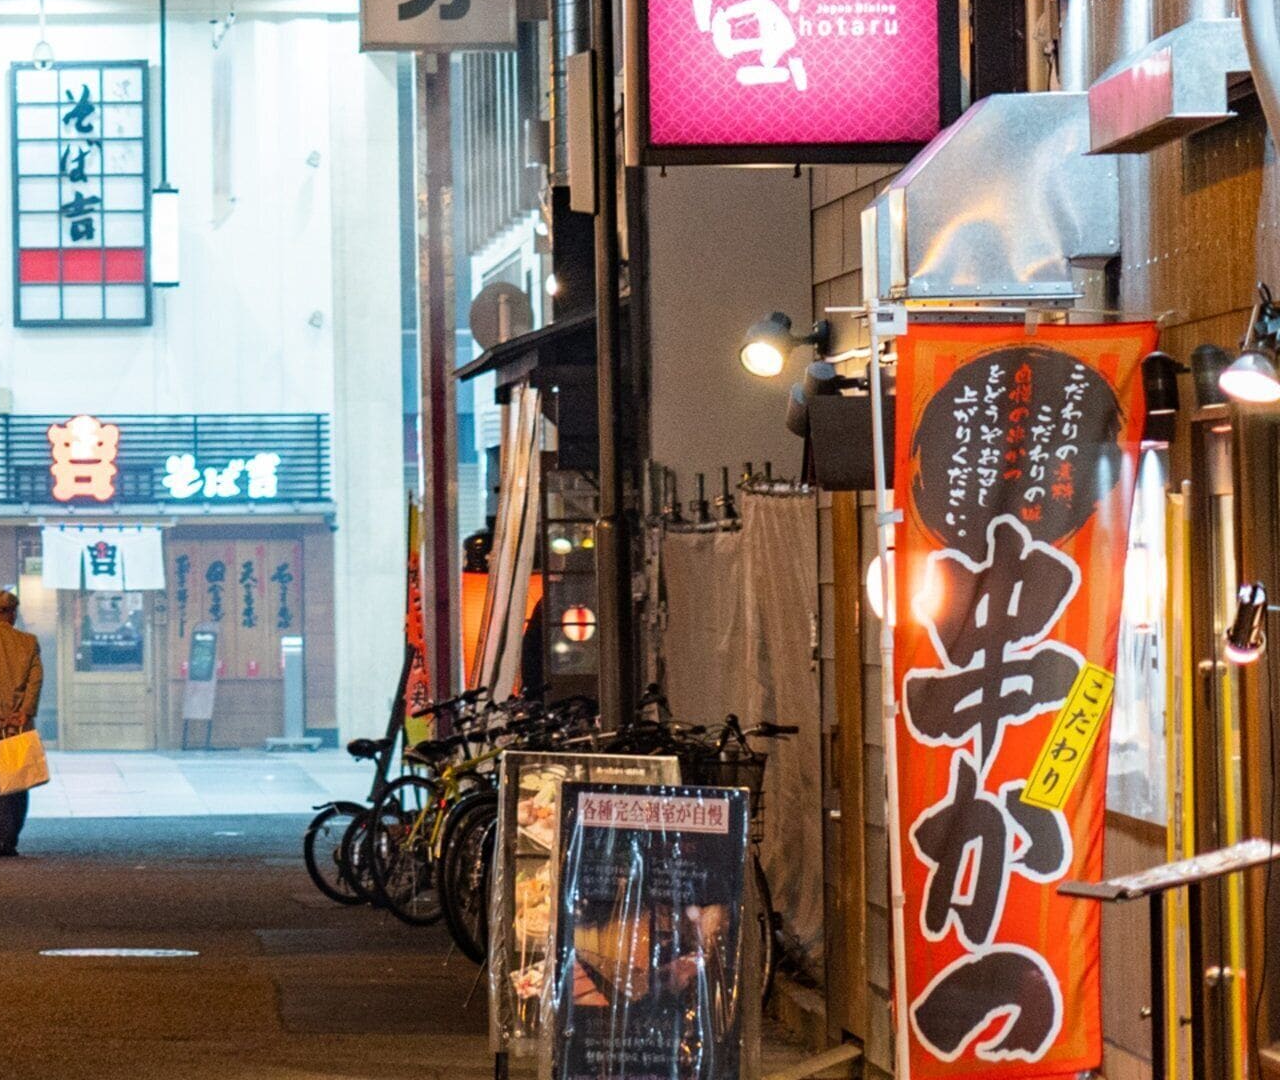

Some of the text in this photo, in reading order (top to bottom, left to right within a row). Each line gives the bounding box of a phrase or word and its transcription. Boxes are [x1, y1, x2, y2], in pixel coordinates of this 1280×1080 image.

[798, 16, 899, 37] hotaru
[58, 84, 104, 242] そば吉
[162, 452, 281, 499] そば吉
[1041, 680, 1104, 796] こだわり
[583, 797, 724, 827] 各種完全個室が自慢
[903, 513, 1087, 1063] 串かつ
